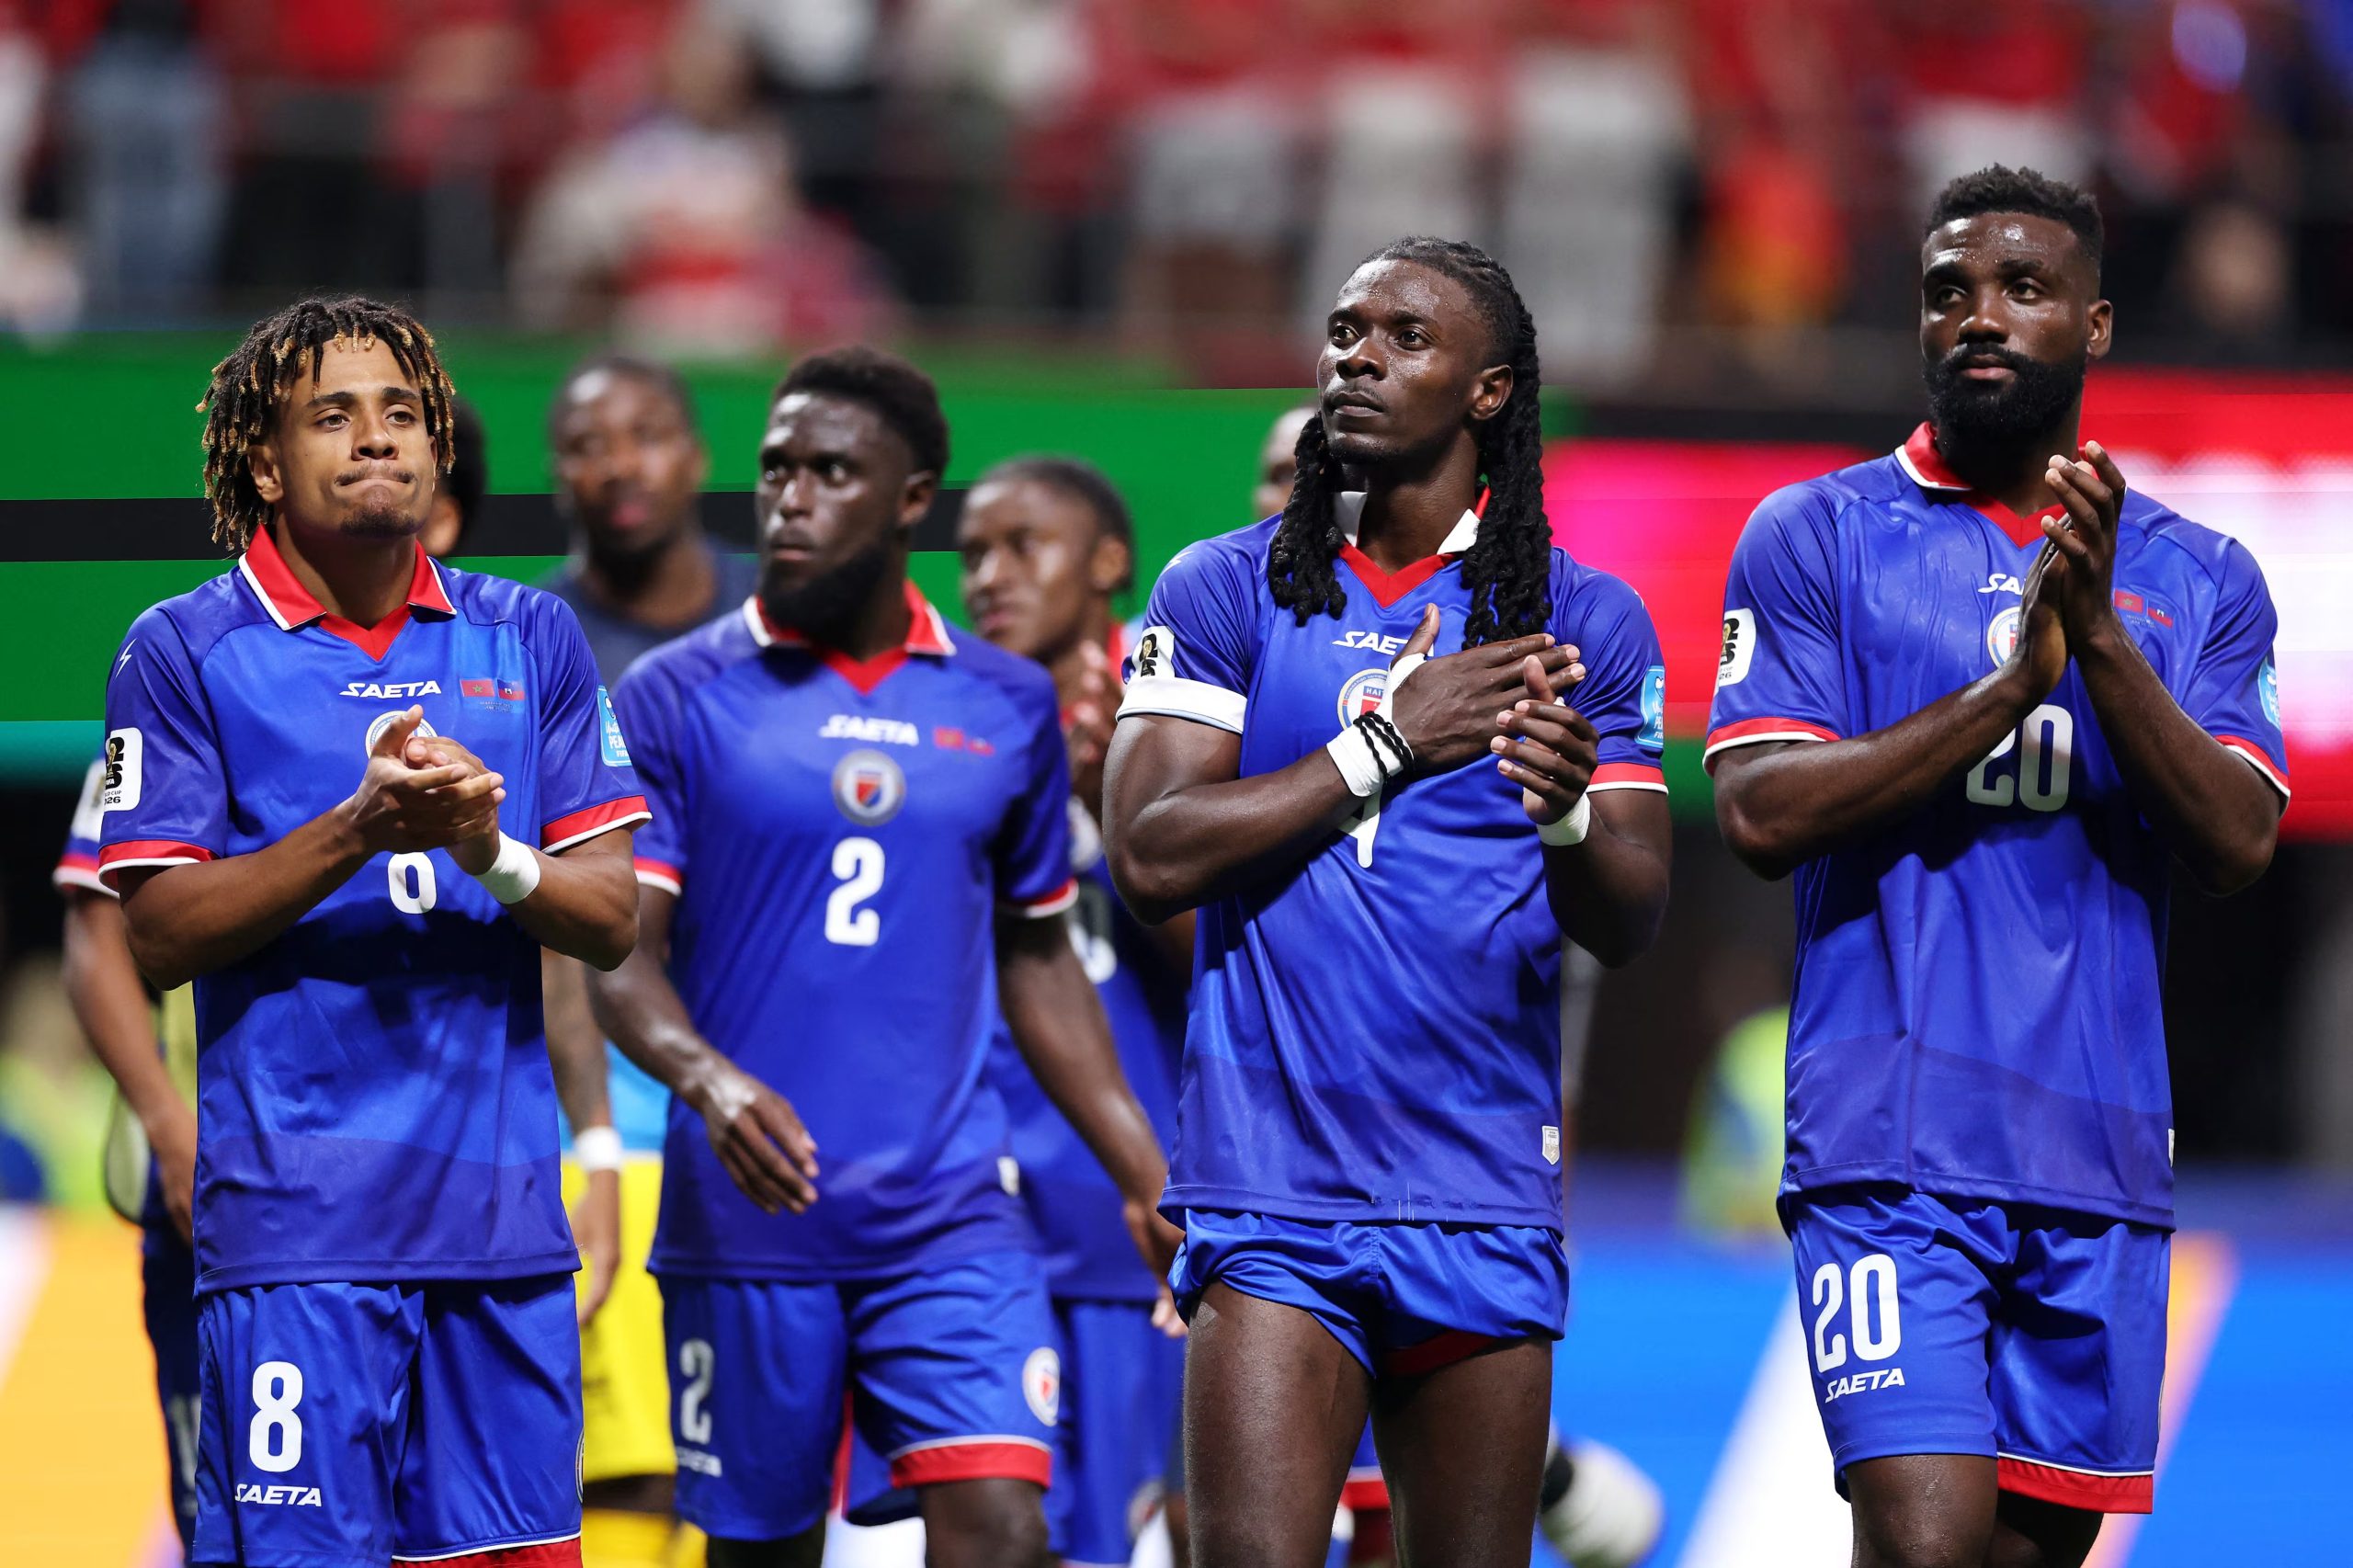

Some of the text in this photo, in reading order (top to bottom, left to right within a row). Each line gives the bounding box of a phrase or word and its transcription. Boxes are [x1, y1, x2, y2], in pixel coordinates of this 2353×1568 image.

[1332, 631, 1435, 657] SAE
[339, 681, 441, 699] SAETA
[818, 714, 919, 746] SAETA
[1966, 704, 2074, 812] 20
[104, 796, 121, 805] 26
[824, 836, 886, 947] 2
[1813, 1254, 1902, 1373] 20
[679, 1339, 714, 1445] 2
[1825, 1369, 1906, 1403] SAETA
[249, 1361, 303, 1472] 8
[234, 1483, 323, 1507] SAETA
